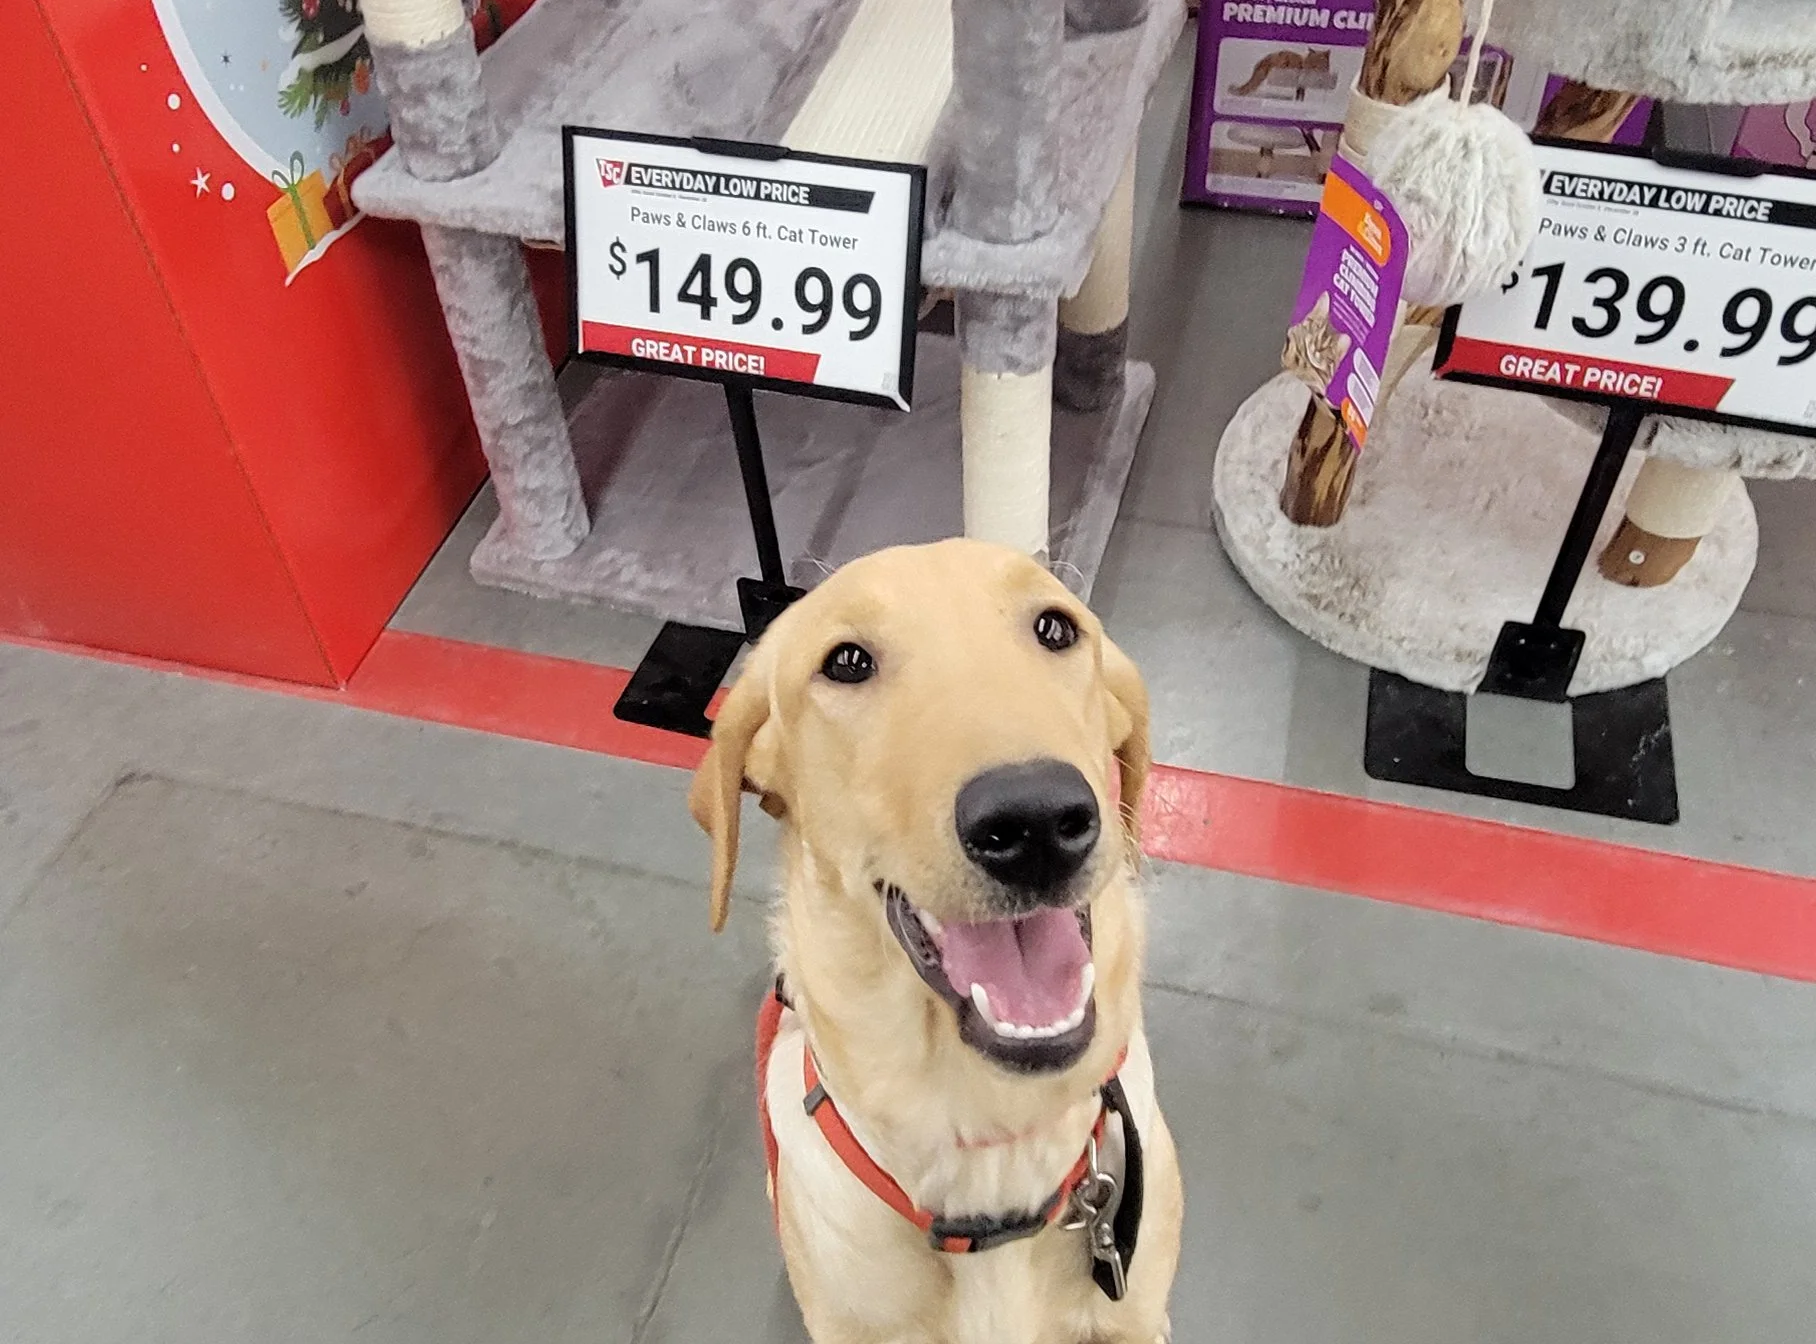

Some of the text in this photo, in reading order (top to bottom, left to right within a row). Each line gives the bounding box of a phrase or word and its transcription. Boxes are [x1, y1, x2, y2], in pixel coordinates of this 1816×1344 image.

[1222, 2, 1330, 29] PREMIUM
[599, 159, 621, 185] TSC
[631, 166, 716, 193] EVERYDAY
[719, 176, 757, 198] LOW
[760, 181, 810, 205] PRICE
[1549, 174, 1657, 206] EVERYDAY
[1658, 187, 1707, 213] LOW
[1708, 194, 1773, 222] PRICE
[631, 206, 859, 251] Paws & Claws 6 ft. Cat Tower
[1538, 217, 1816, 272] Paws & Claws 3 ft. Cat Tower
[608, 236, 882, 342] $149.99
[631, 337, 765, 376] GREAT PRICE!
[1500, 354, 1664, 400] GREAT PRICE!
